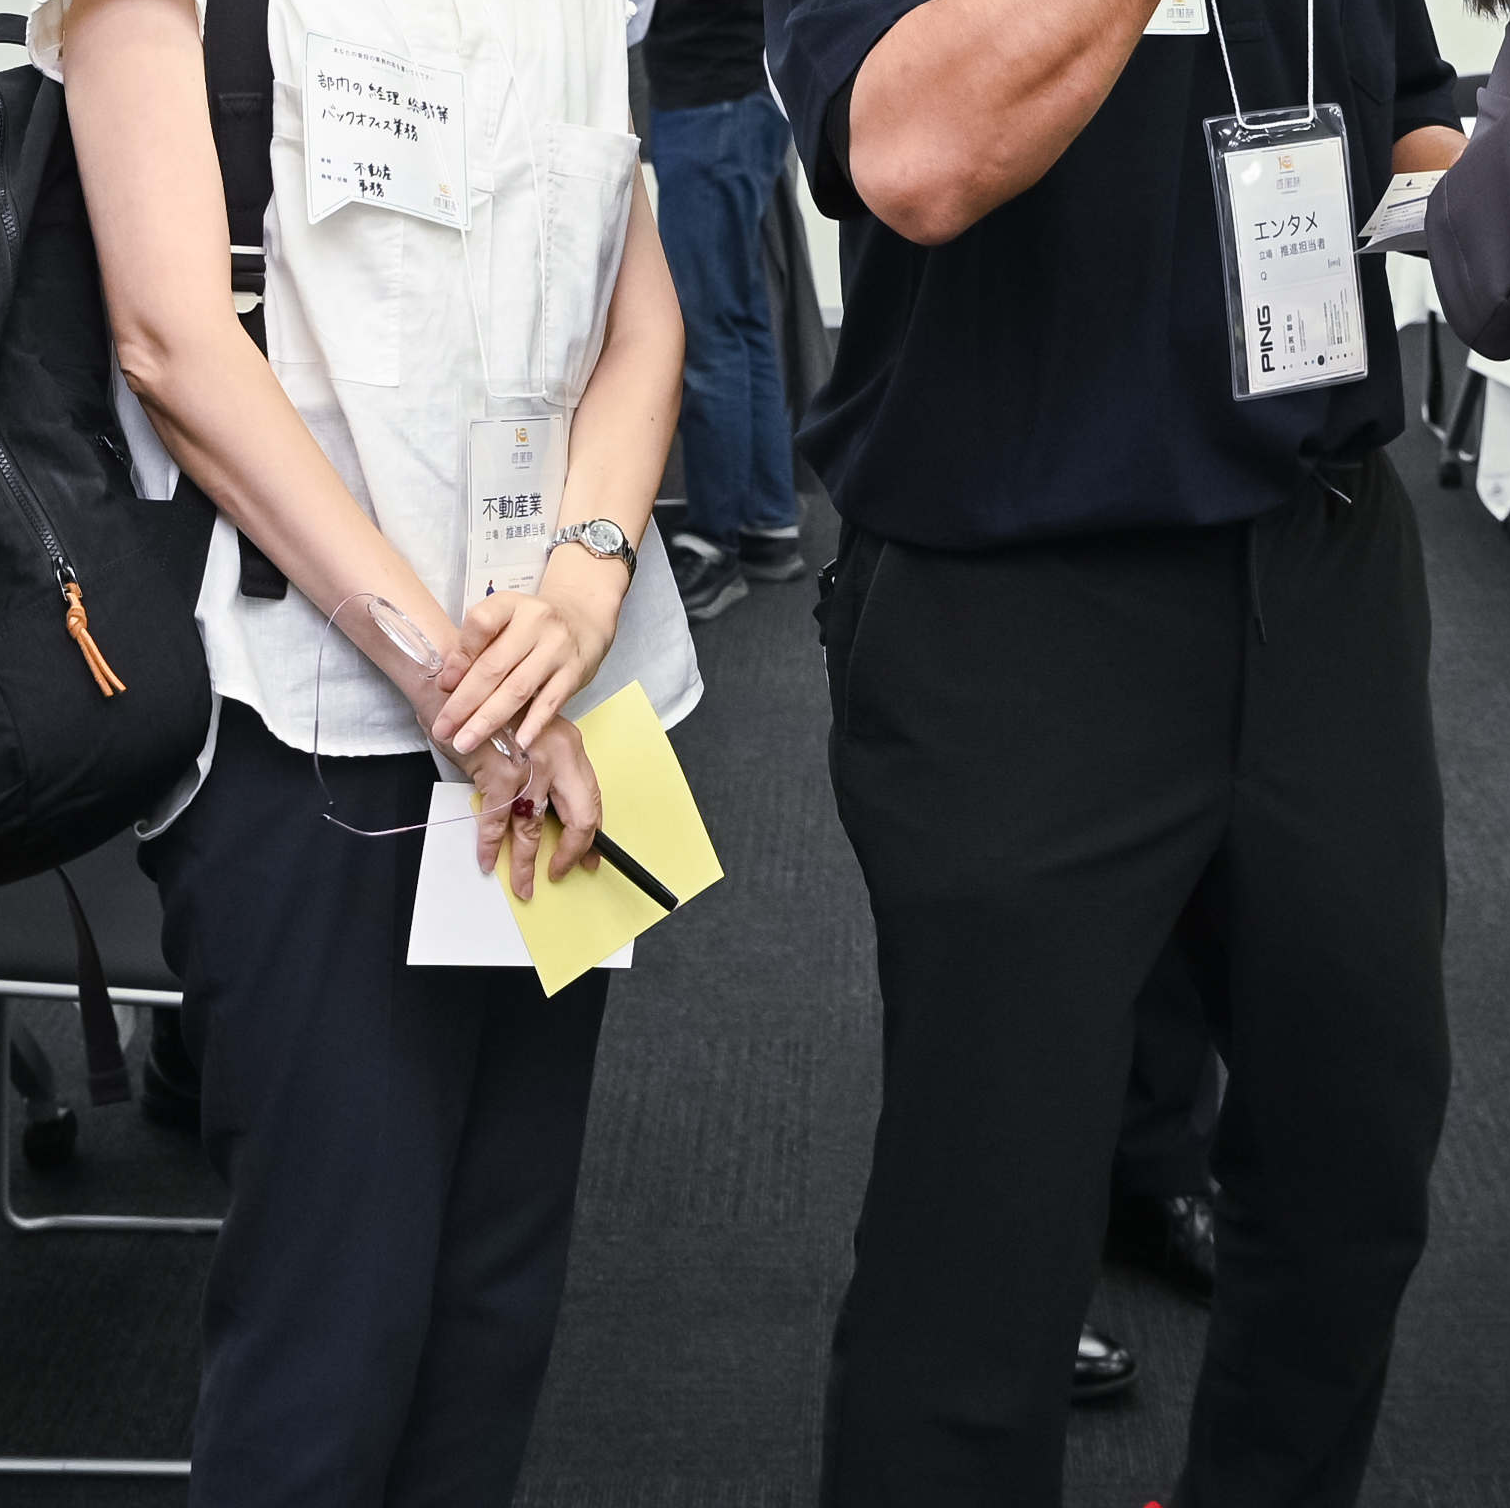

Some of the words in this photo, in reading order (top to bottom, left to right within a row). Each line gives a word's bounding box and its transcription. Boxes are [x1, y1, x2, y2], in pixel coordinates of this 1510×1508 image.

[353, 163, 392, 180] 不動産
[358, 179, 385, 198] 事務
[1254, 211, 1318, 241] エンタメ
[1260, 271, 1267, 281] Q
[1257, 305, 1275, 373] PING
[482, 492, 543, 522] 不動産業
